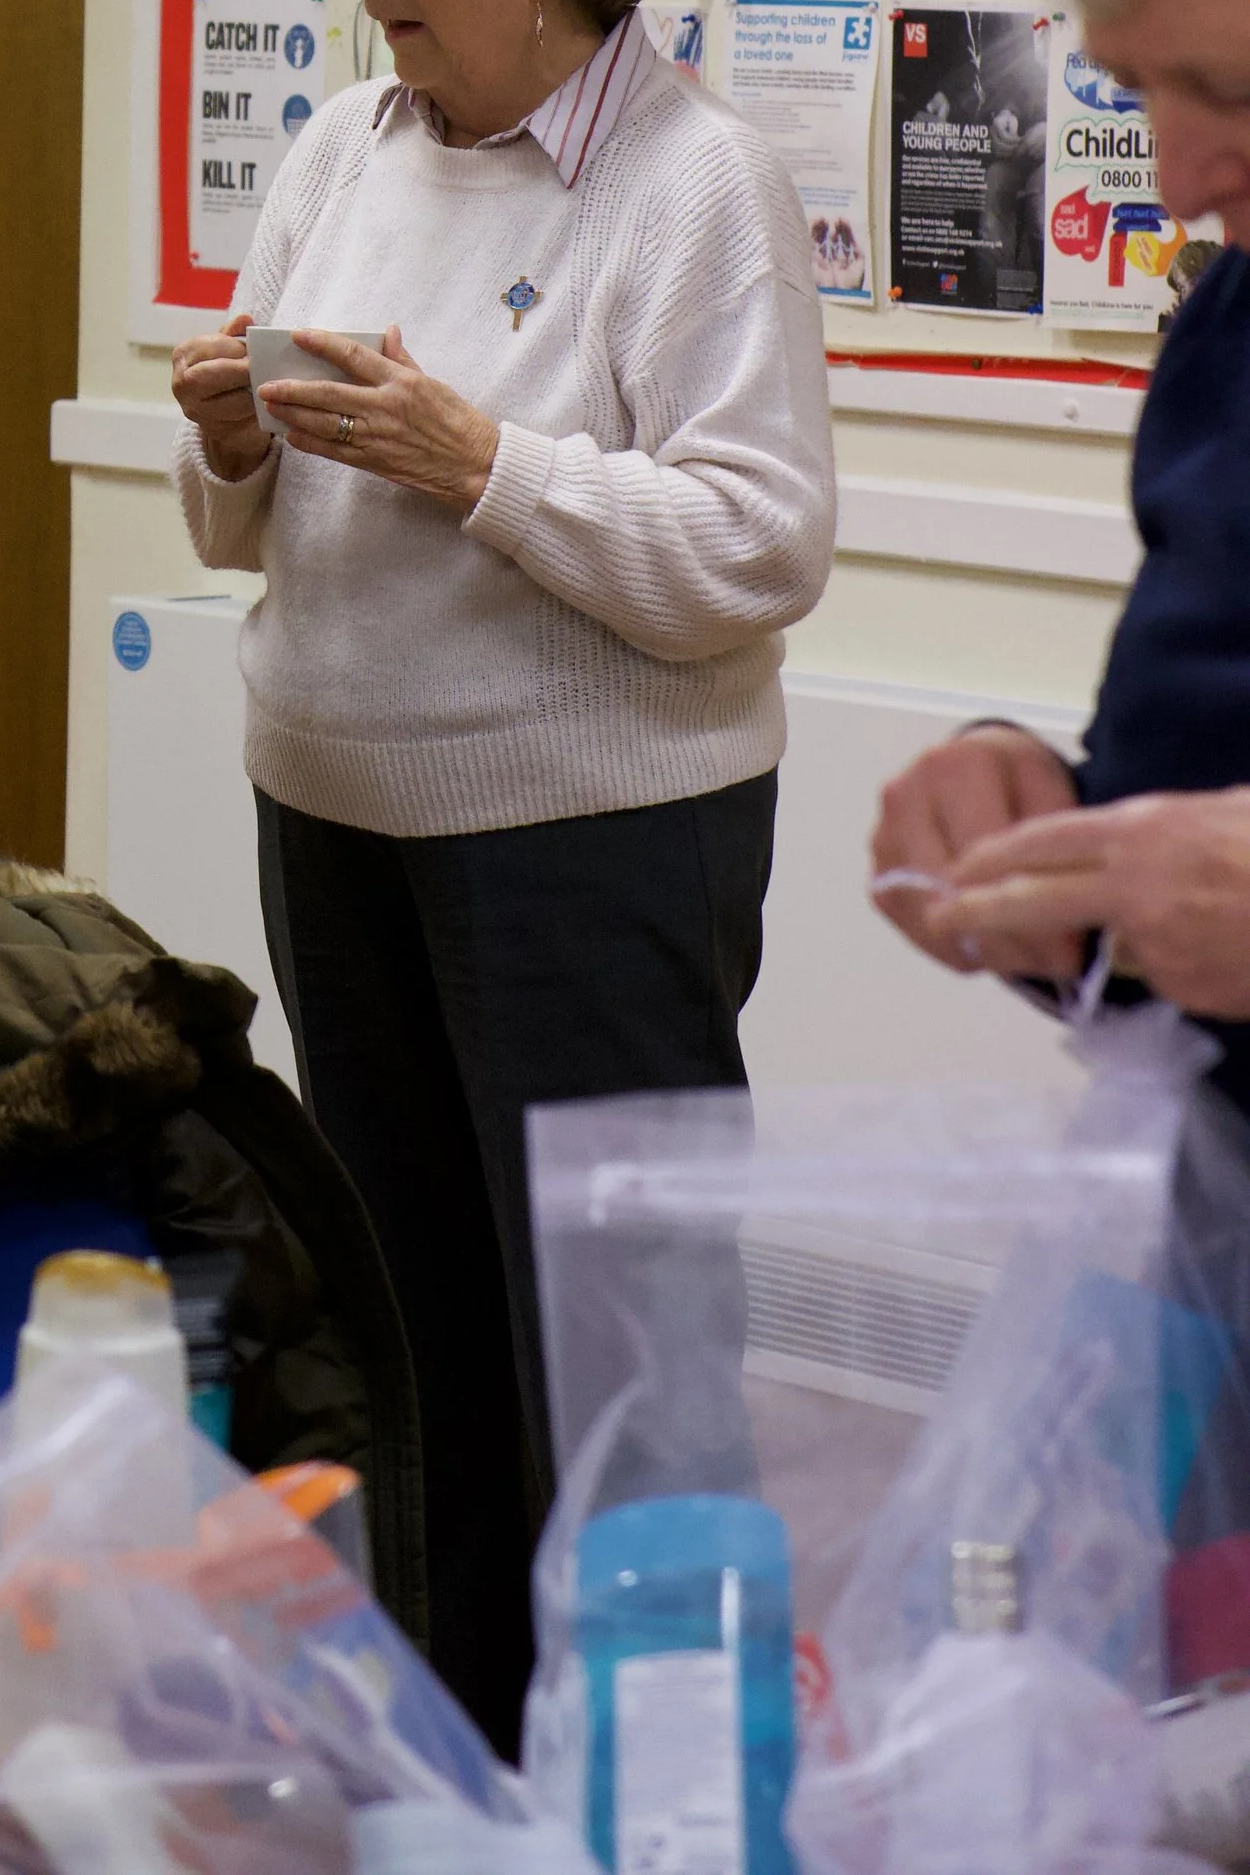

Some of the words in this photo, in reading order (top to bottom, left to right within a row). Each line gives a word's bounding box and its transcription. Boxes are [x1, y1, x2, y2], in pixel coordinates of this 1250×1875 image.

[736, 11, 788, 29] Supporting
[790, 12, 836, 26] children
[205, 21, 257, 52] CATCH
[263, 24, 280, 53] IT
[735, 30, 773, 46] through
[775, 32, 791, 44] the
[794, 33, 813, 45] loss
[817, 34, 827, 44] of
[906, 24, 926, 43] VS
[734, 51, 741, 61] a
[743, 48, 772, 61] loved
[775, 51, 794, 62] one
[203, 91, 229, 121] BIN
[236, 92, 252, 121] IT
[903, 120, 961, 137] CHILDREN
[963, 124, 989, 138] AND
[903, 135, 942, 151] YOUNG
[945, 138, 992, 153] PEOPLE
[202, 160, 235, 190] KILL
[241, 162, 256, 191] IT
[1101, 170, 1142, 188] 0800
[1054, 213, 1089, 240] sad
